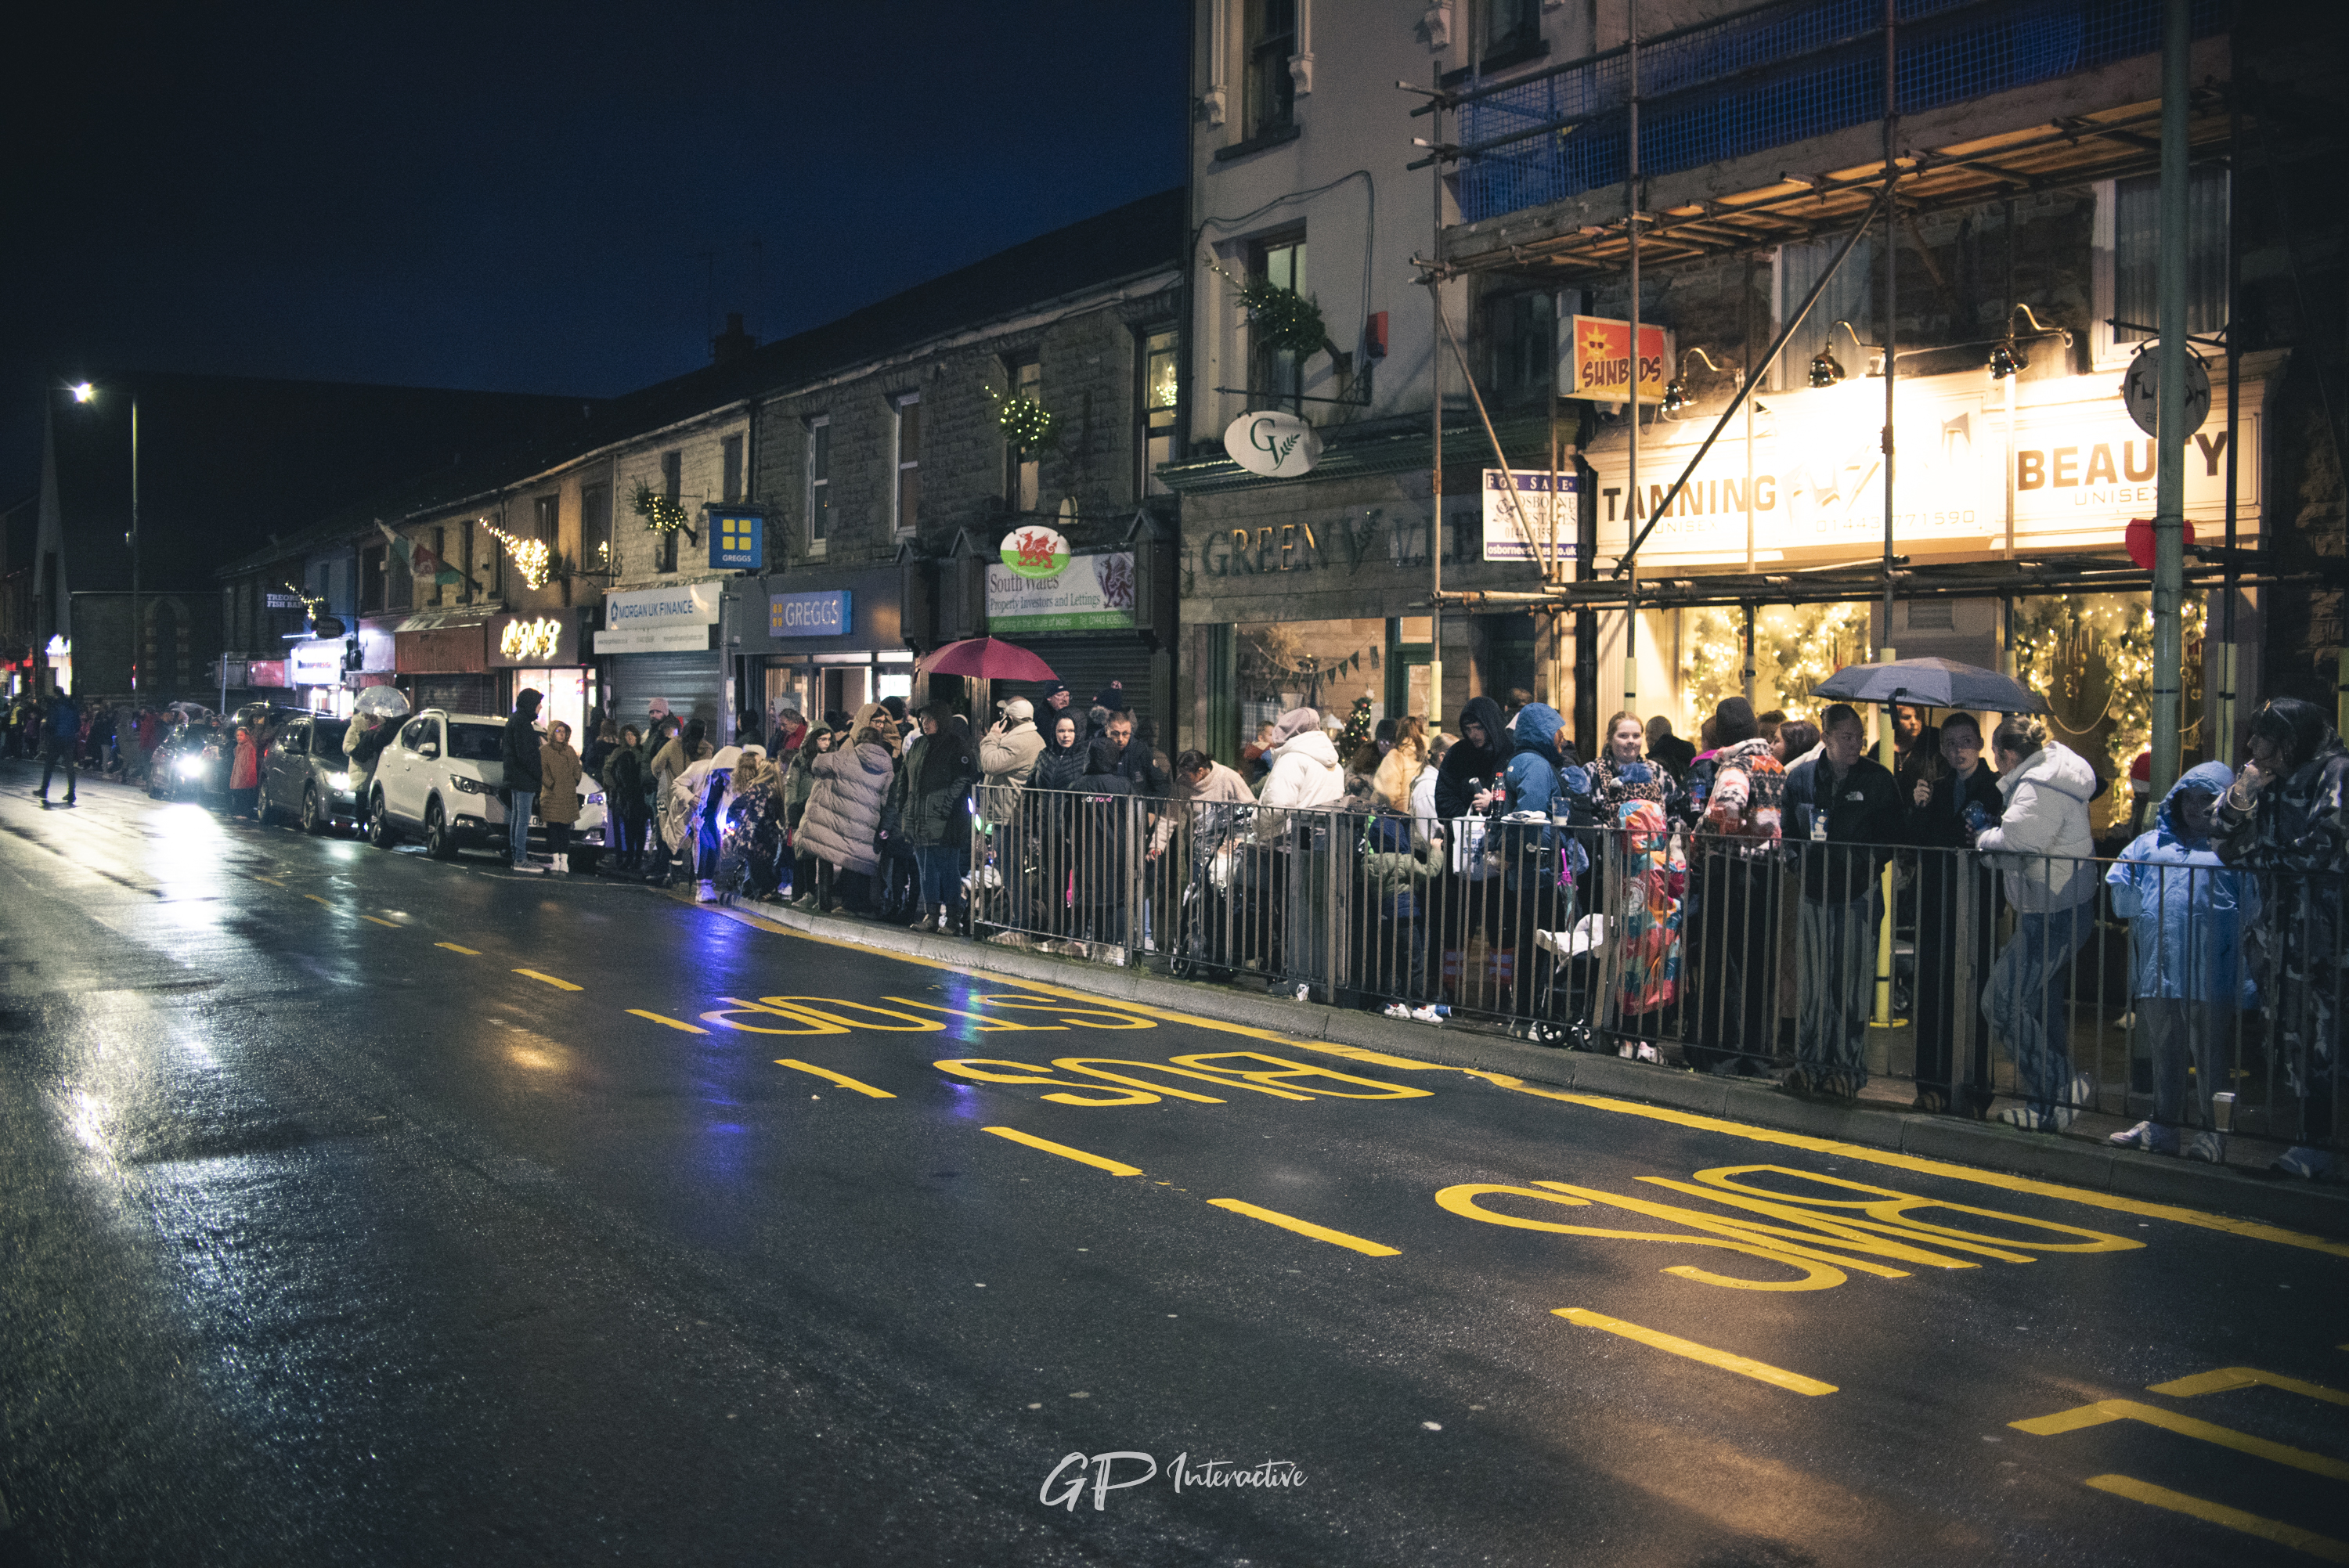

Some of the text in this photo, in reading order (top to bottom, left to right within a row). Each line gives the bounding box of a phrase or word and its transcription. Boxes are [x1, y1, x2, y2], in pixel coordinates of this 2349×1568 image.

[1582, 355, 1661, 387] SUNBDS
[2018, 431, 2228, 492] BEAUY
[1488, 475, 1569, 491] FOR SAE
[1518, 496, 1576, 509] OSBONE
[1602, 475, 1776, 522] TANNING
[1525, 513, 1576, 525] ESTTES
[1817, 510, 1975, 532] 01443 771590
[1201, 522, 1333, 577] GREEN
[990, 573, 1059, 593] South Wales
[619, 600, 694, 618] MORGAN UK FINANCE
[785, 600, 839, 627] GREGGS
[990, 593, 1101, 613] Property Investors and Lettings
[699, 993, 1159, 1036] STOP
[933, 1051, 1436, 1107] BUS
[1435, 1164, 2148, 1292] BWS
